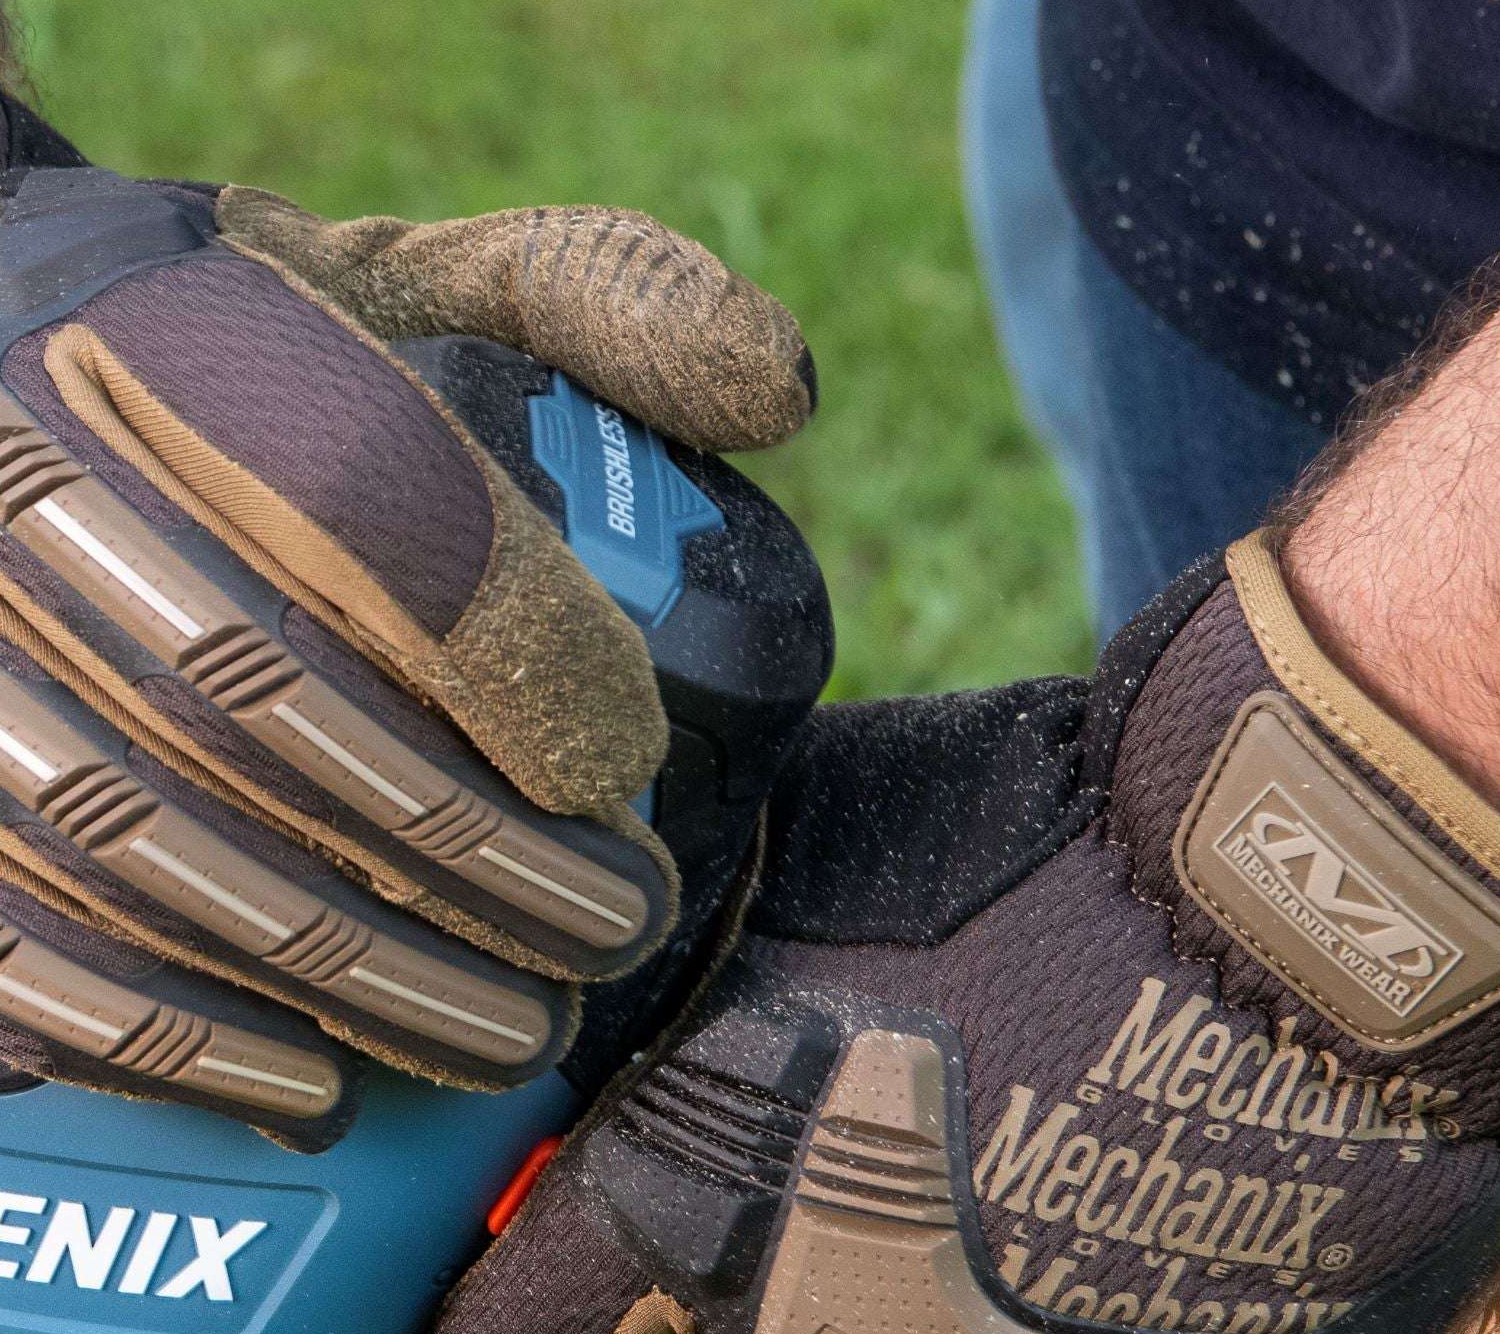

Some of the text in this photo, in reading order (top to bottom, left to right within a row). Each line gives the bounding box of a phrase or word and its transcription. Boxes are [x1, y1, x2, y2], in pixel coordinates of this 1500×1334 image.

[594, 402, 635, 539] BRUSHLESS
[1226, 833, 1412, 1006] MECHANIX WEAR
[974, 1083, 1346, 1268] Mechanix
[1012, 1220, 1300, 1287] LOVES
